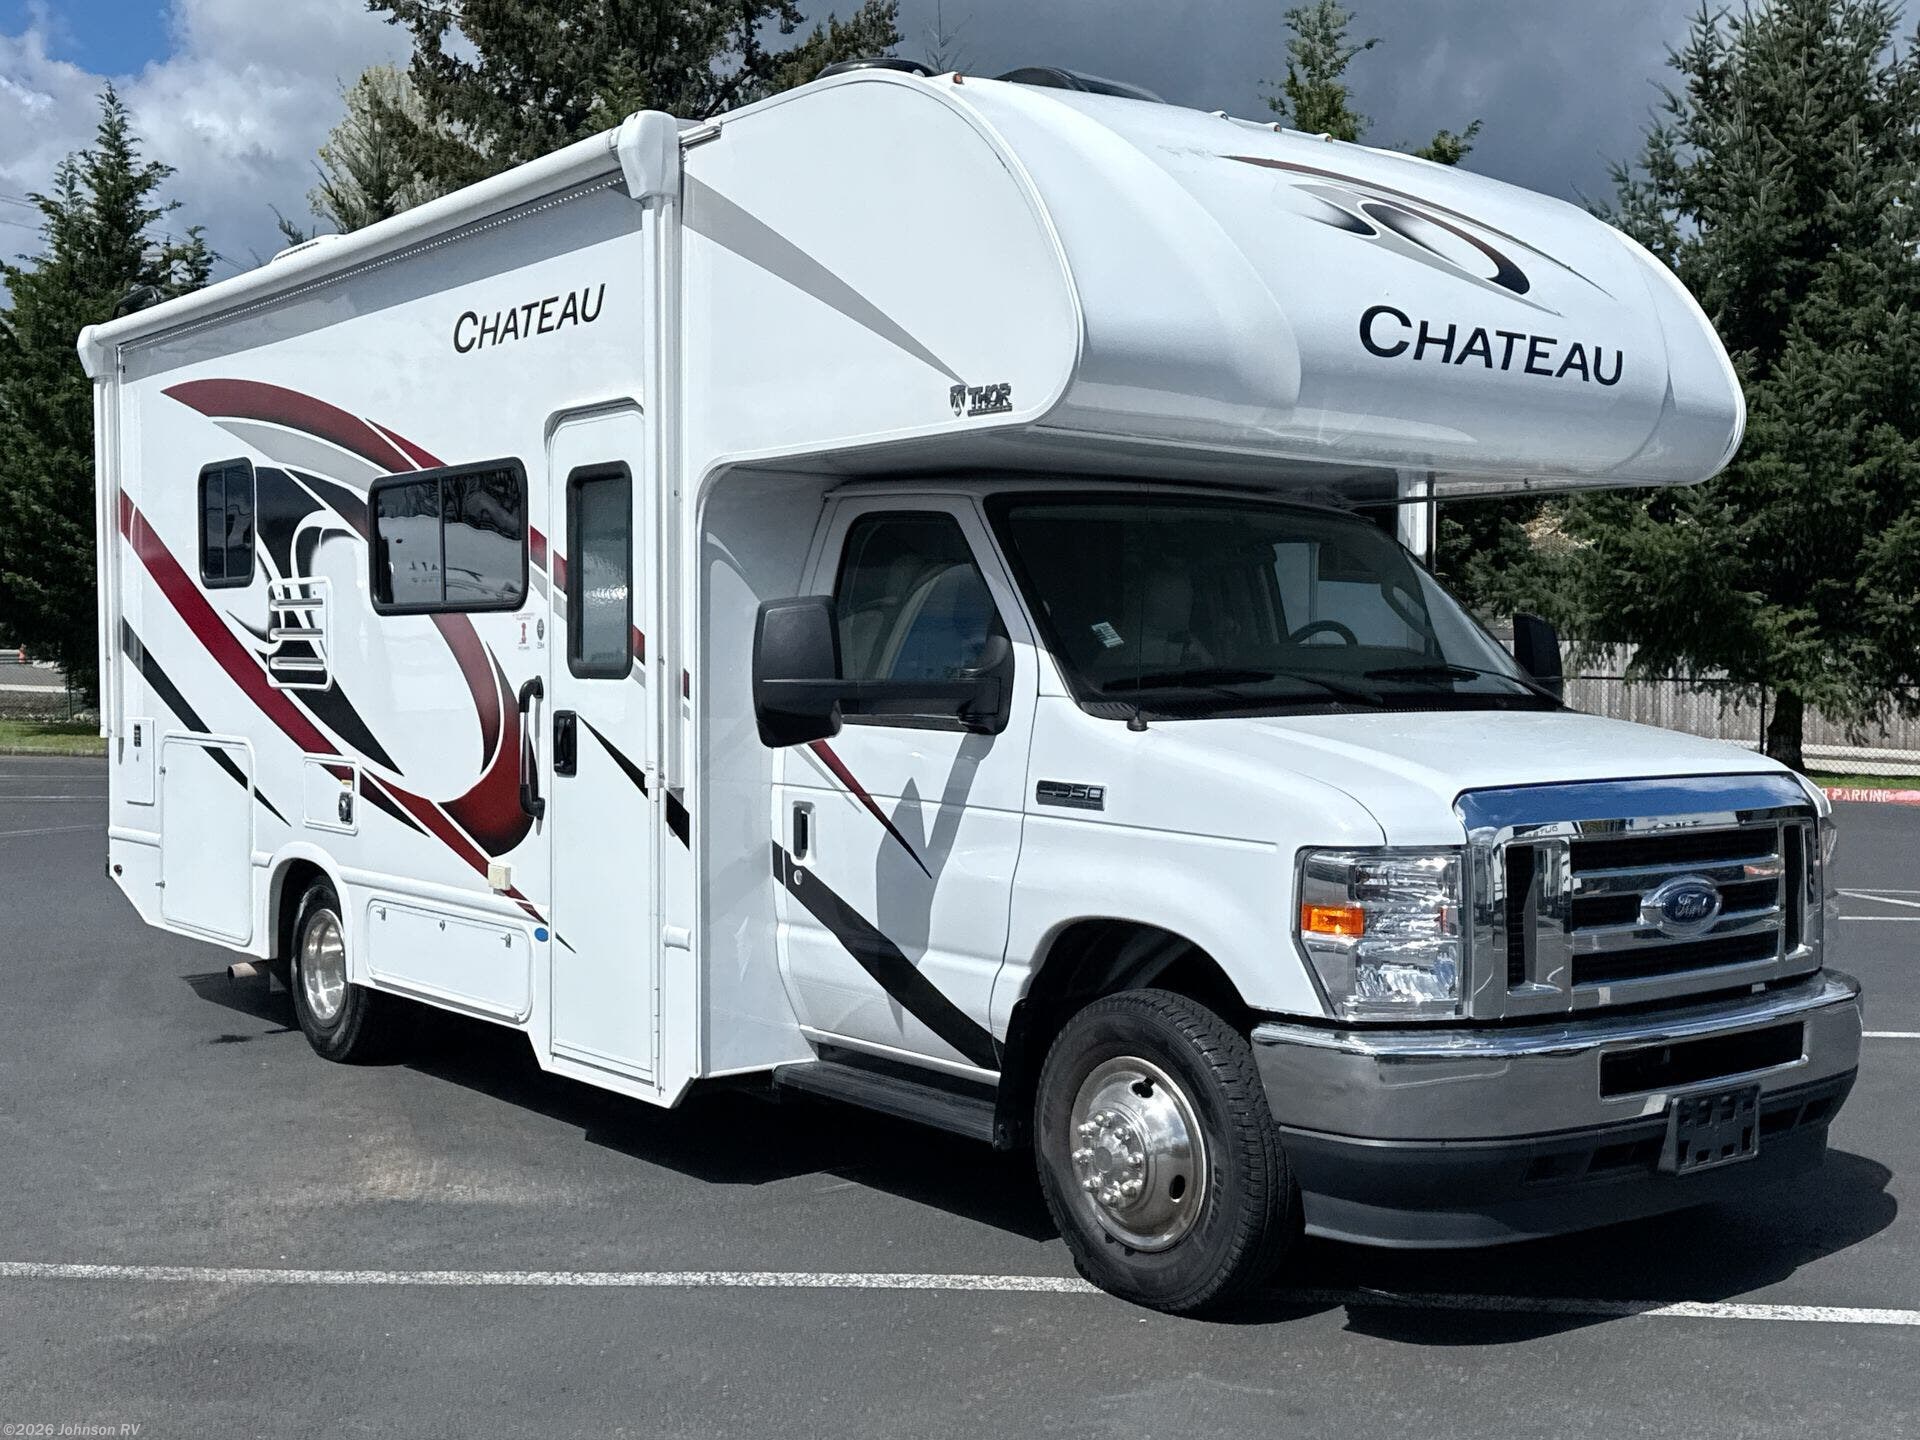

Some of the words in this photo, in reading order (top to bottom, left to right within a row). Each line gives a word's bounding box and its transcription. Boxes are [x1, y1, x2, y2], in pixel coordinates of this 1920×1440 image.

[453, 283, 606, 354] CHATEAU
[1359, 304, 1623, 386] CHATEAU
[967, 383, 1013, 409] THOR
